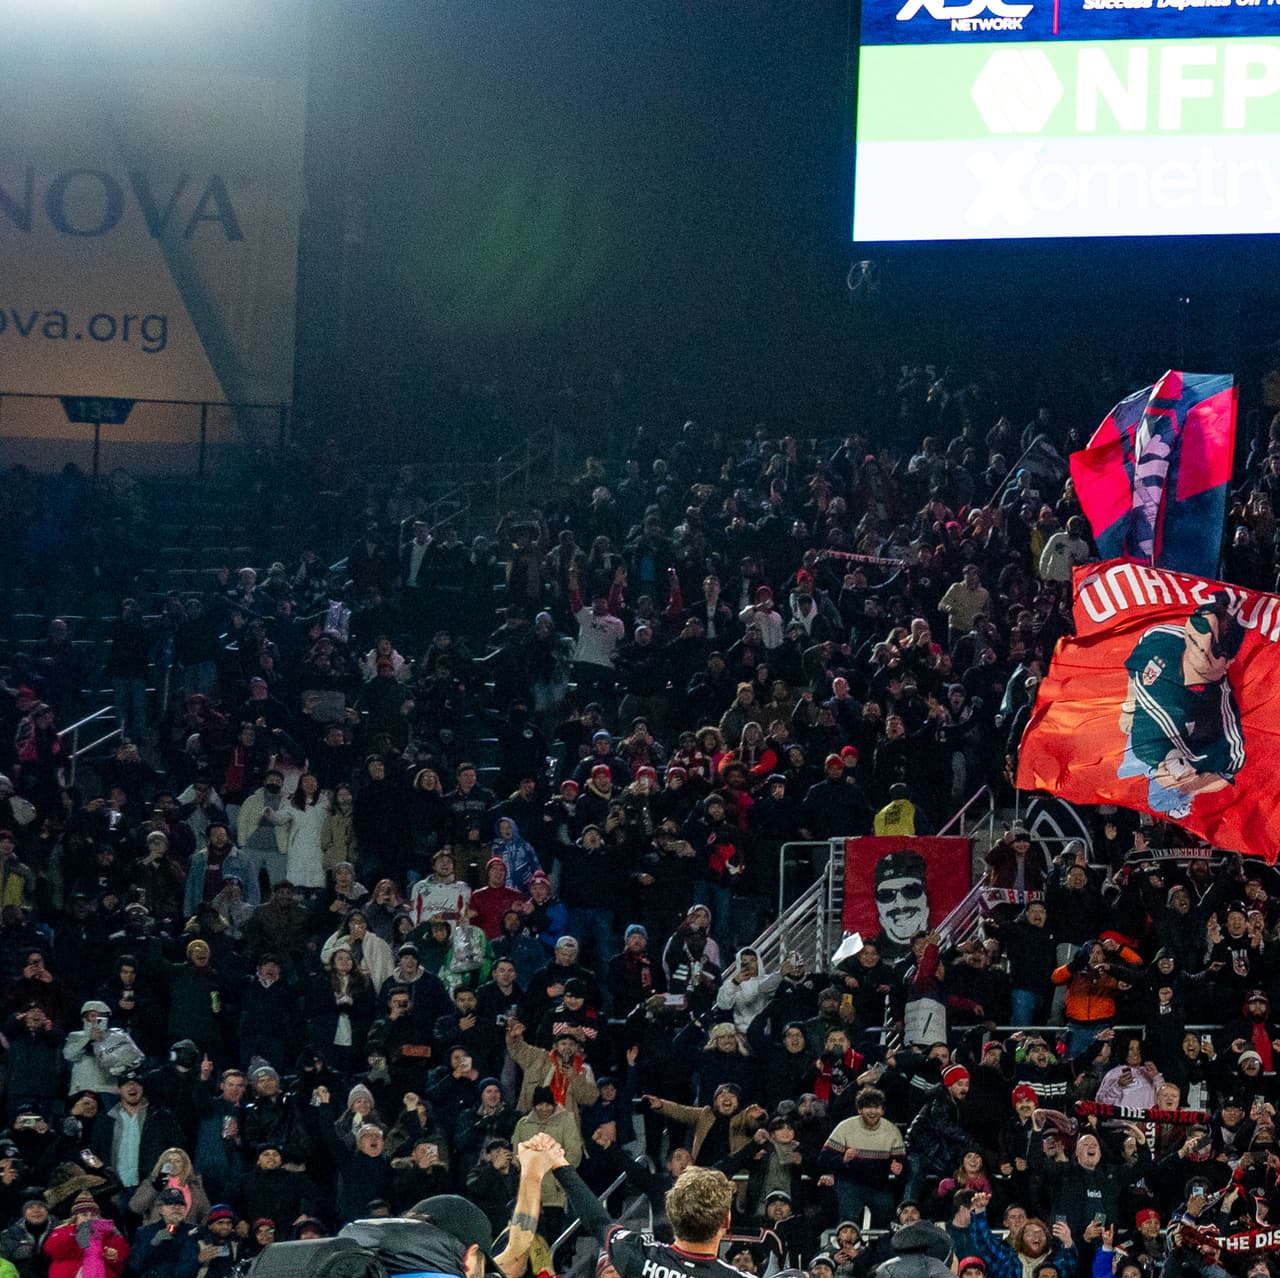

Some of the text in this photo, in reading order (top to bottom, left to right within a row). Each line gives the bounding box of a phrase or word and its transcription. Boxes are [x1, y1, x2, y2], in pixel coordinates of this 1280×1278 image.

[951, 18, 1023, 32] NETWORK
[1119, 1105, 1146, 1119] THE
[1214, 1235, 1250, 1252] THE
